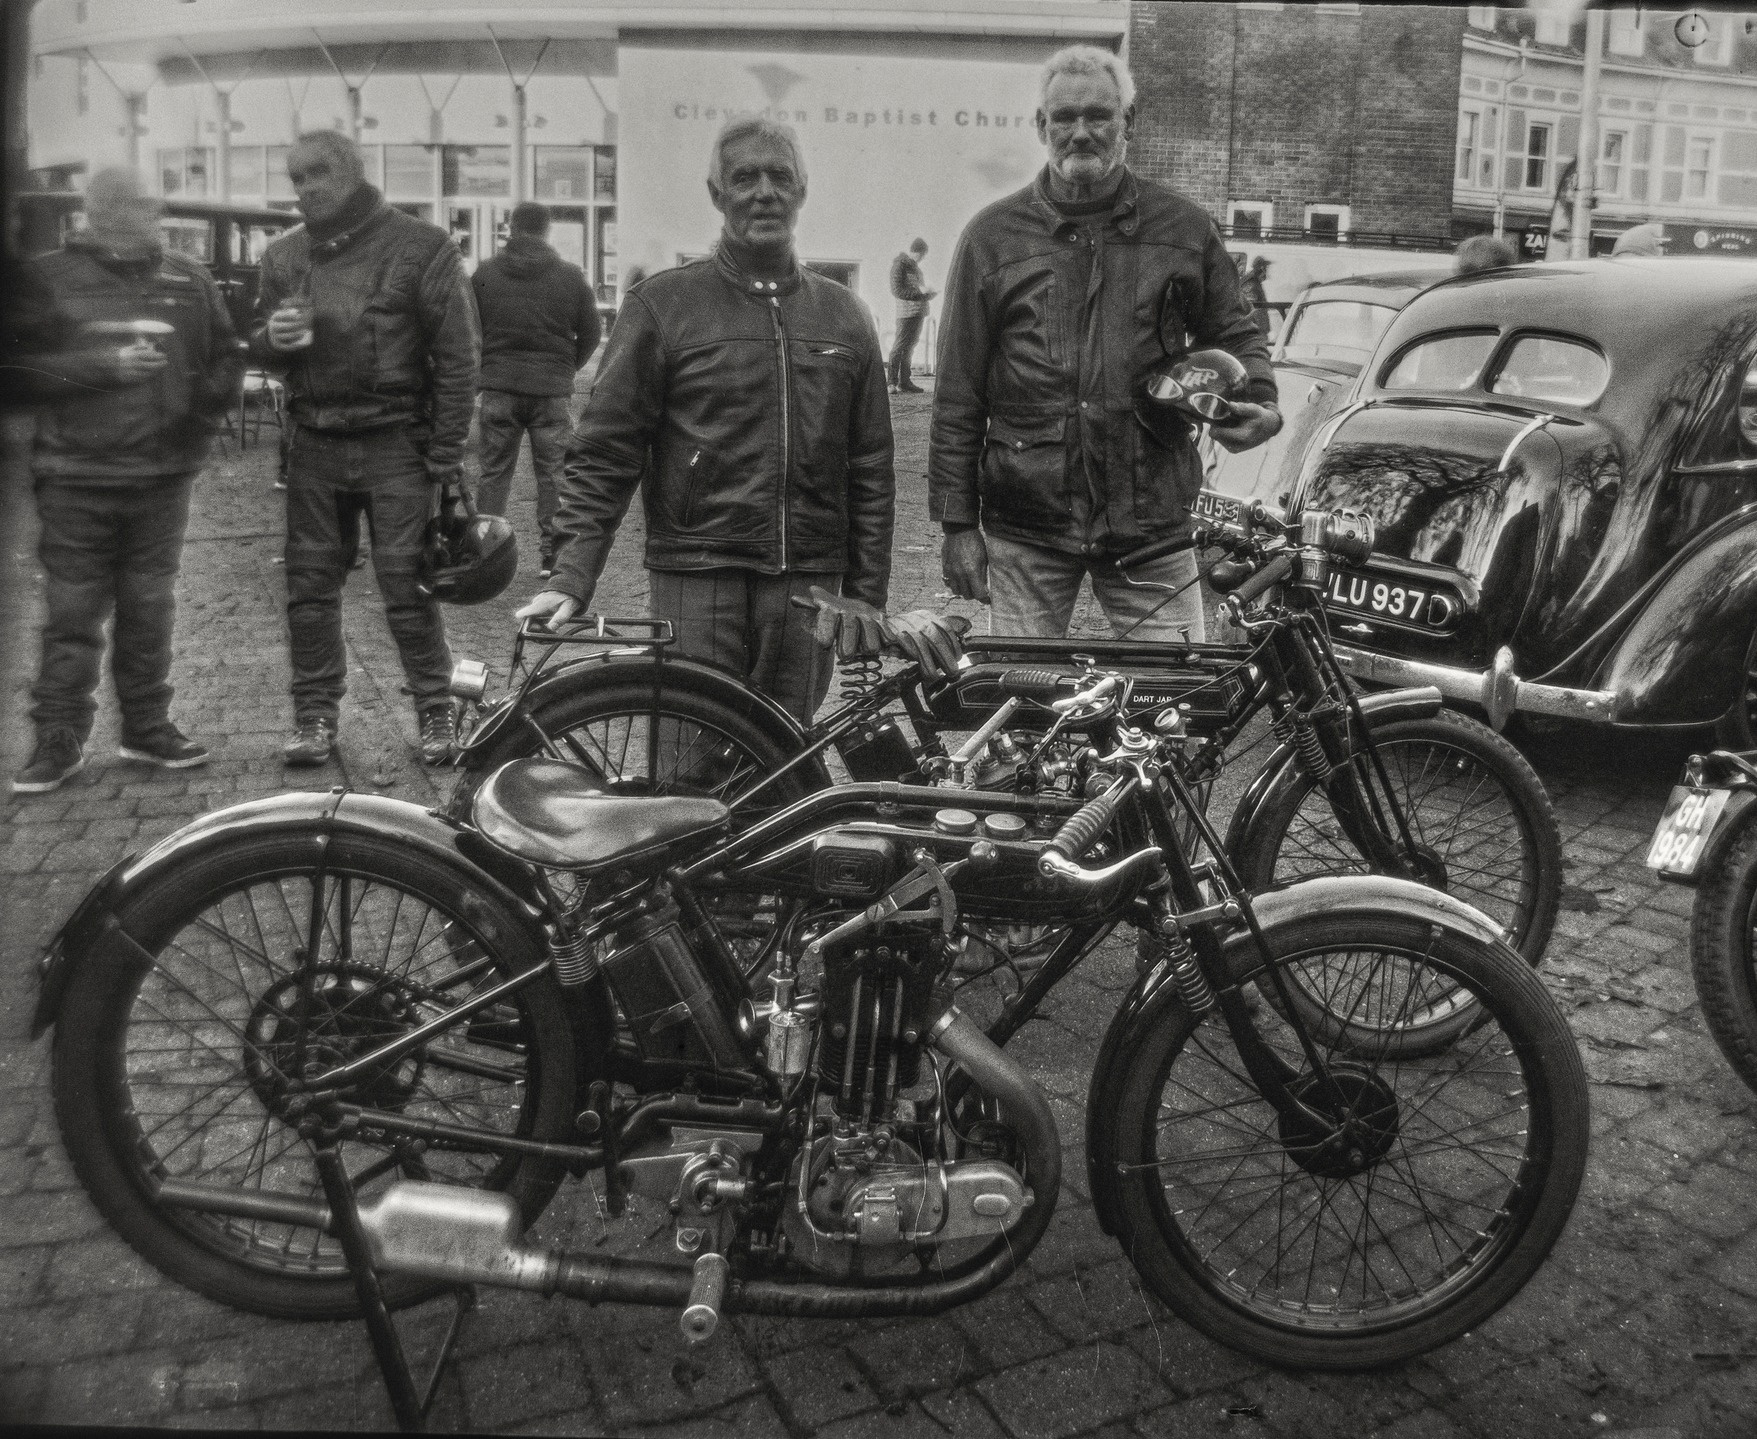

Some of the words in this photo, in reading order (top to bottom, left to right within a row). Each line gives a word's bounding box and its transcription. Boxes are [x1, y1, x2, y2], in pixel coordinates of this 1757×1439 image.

[824, 107, 936, 129] Baptist
[1371, 583, 1425, 619] 937
[1133, 695, 1154, 703] DART
[1156, 695, 1172, 703] JAP
[1675, 794, 1711, 829] GH
